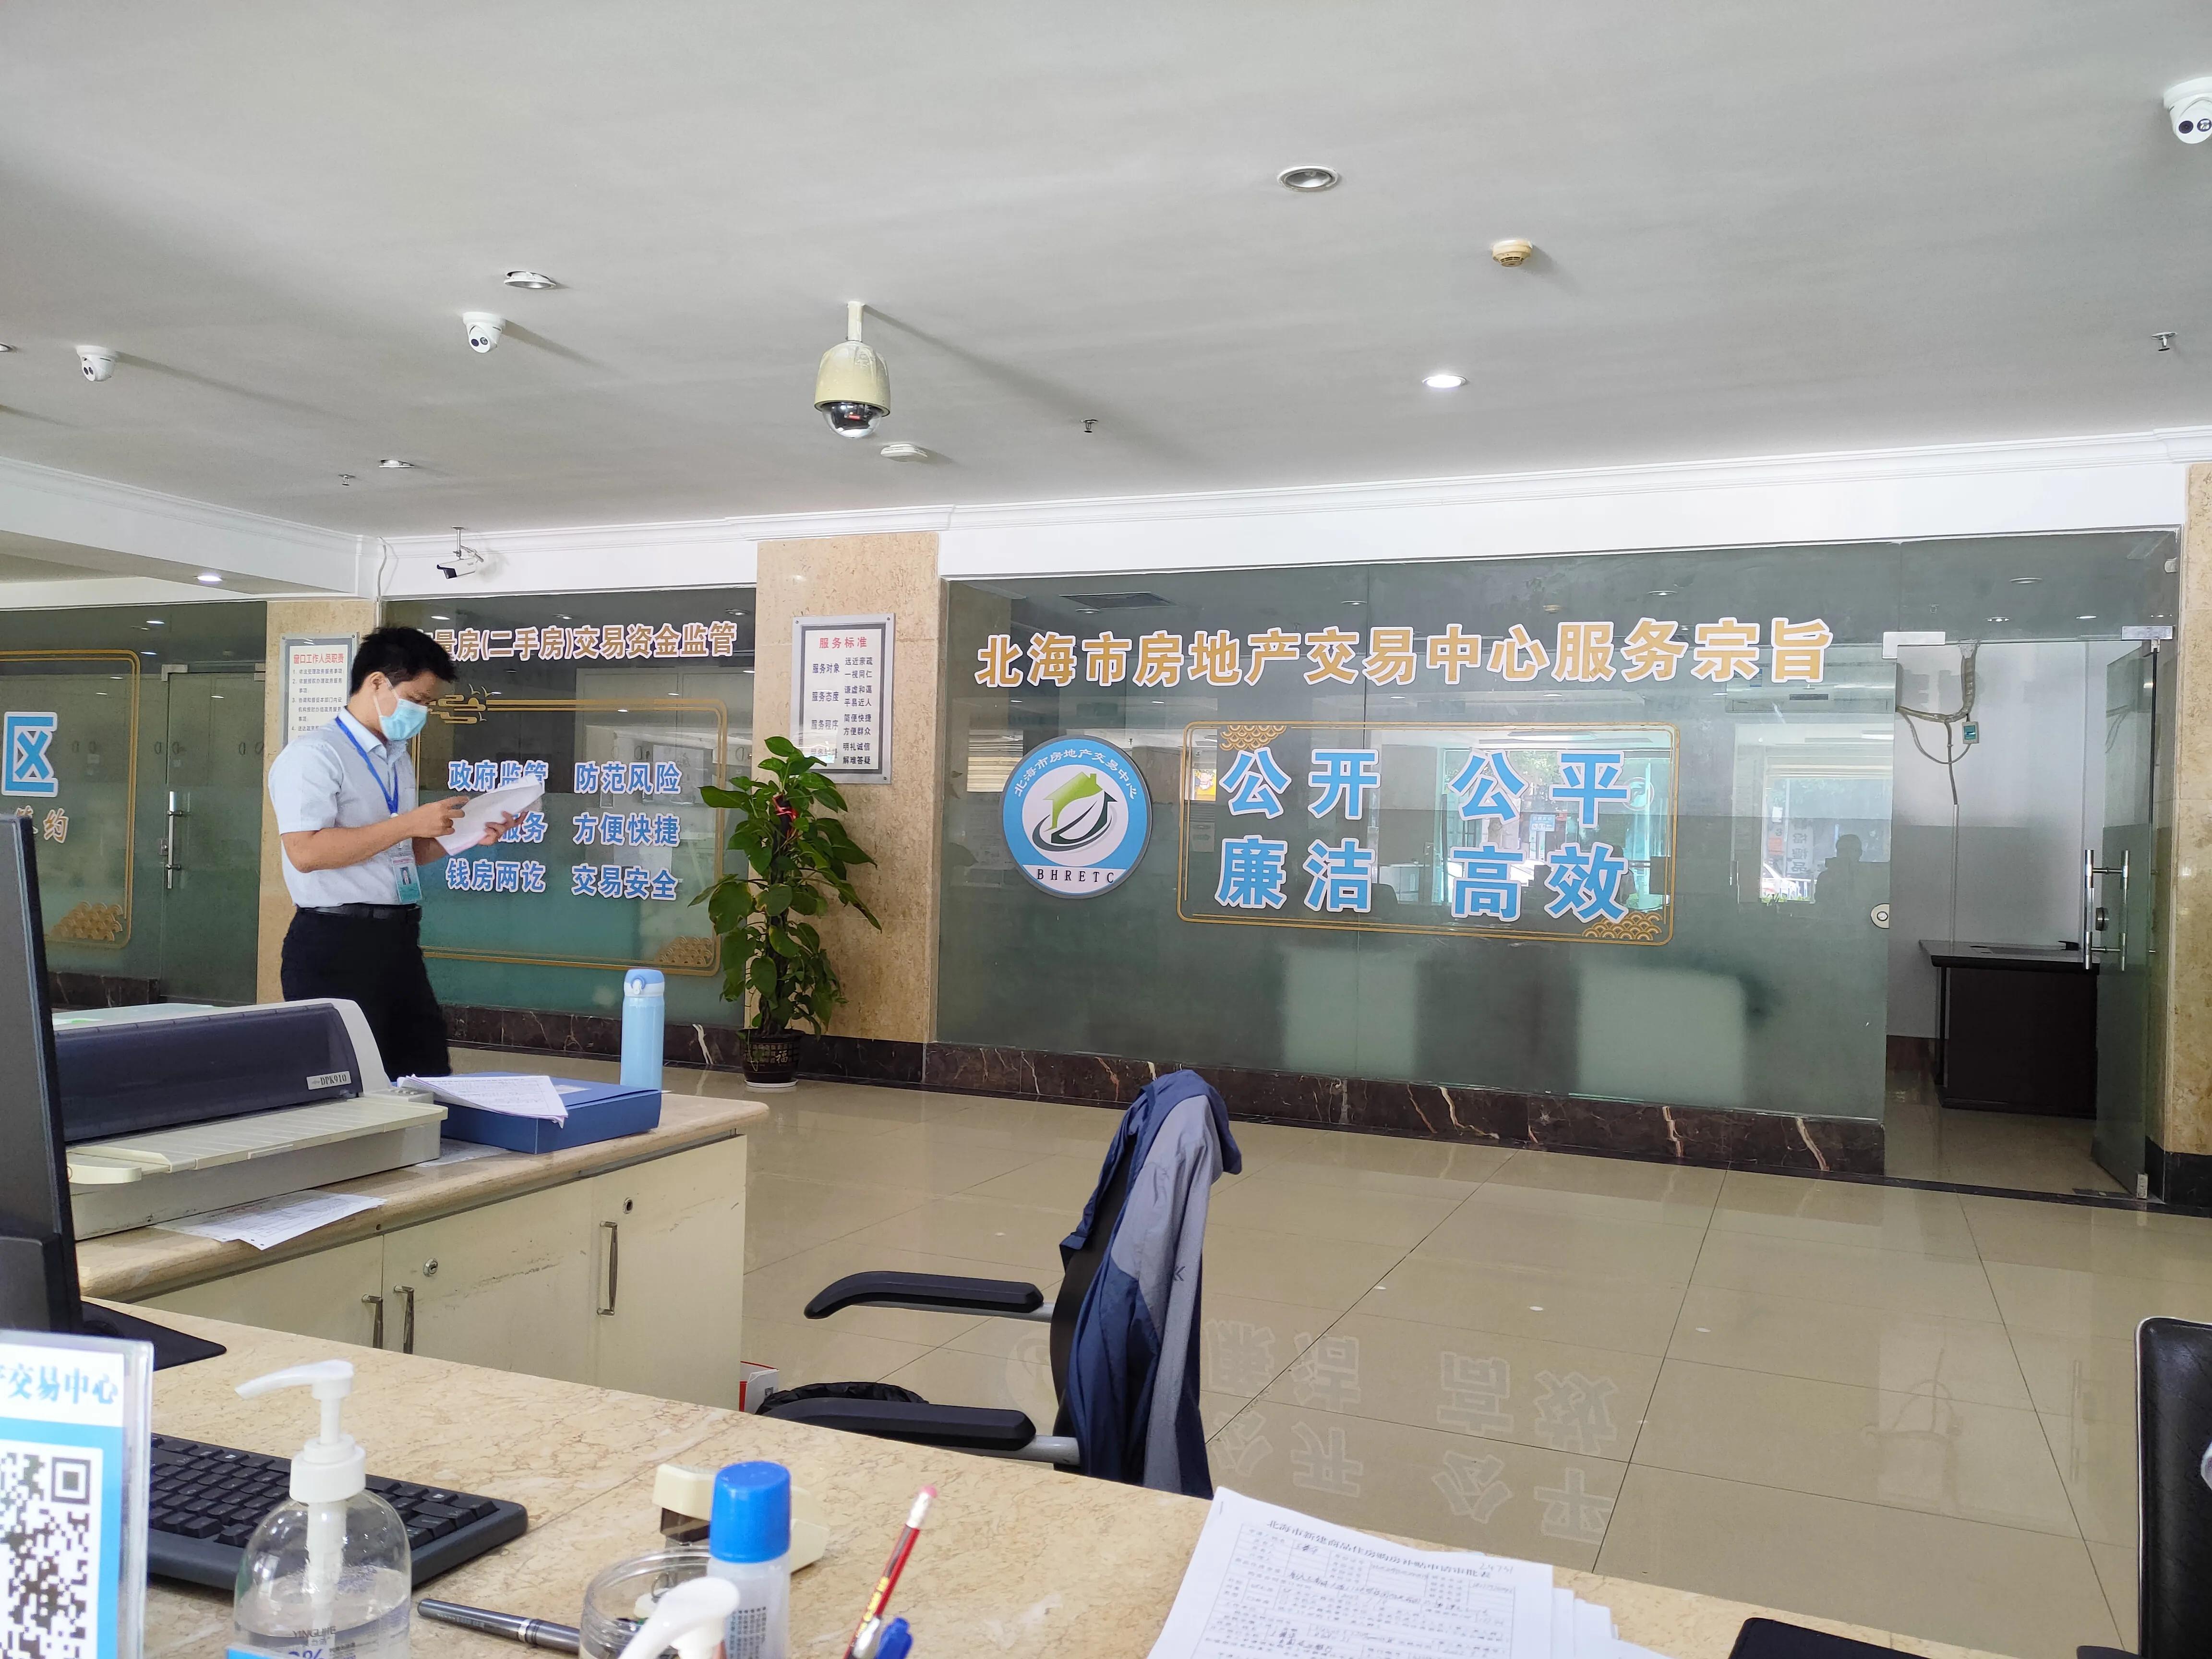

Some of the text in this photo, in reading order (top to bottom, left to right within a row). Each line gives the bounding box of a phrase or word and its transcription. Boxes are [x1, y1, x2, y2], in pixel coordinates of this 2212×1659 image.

[417, 621, 737, 661] 量房(二手房)交易资金监管
[819, 637, 867, 649] 服务标准
[975, 617, 1833, 688] 北海市房地产交易中心服务宗旨
[294, 653, 344, 664] 窗口工作人员职责
[812, 663, 840, 673] 服务对象
[844, 670, 872, 678] 一视同仁
[812, 691, 839, 701] 服务态度
[844, 698, 872, 707] 平易近人
[844, 713, 871, 722] 简便快捷
[811, 720, 838, 730] 服务程序
[843, 727, 871, 735] 方便群众
[843, 742, 870, 751] 明礼诚信
[1, 711, 59, 798] 区
[842, 756, 871, 764] 解难答疑
[574, 761, 682, 794] 防范风险
[1014, 749, 1136, 799] 北海市房地产交易中心
[1220, 746, 1632, 828] 公开 公平
[572, 812, 680, 847] 方便快捷
[445, 858, 678, 900] 钱房两讫 交易安全
[1214, 834, 1629, 923] 廉洁 高效
[320, 1074, 347, 1085] DPK910
[0, 1363, 119, 1405] 交易中心
